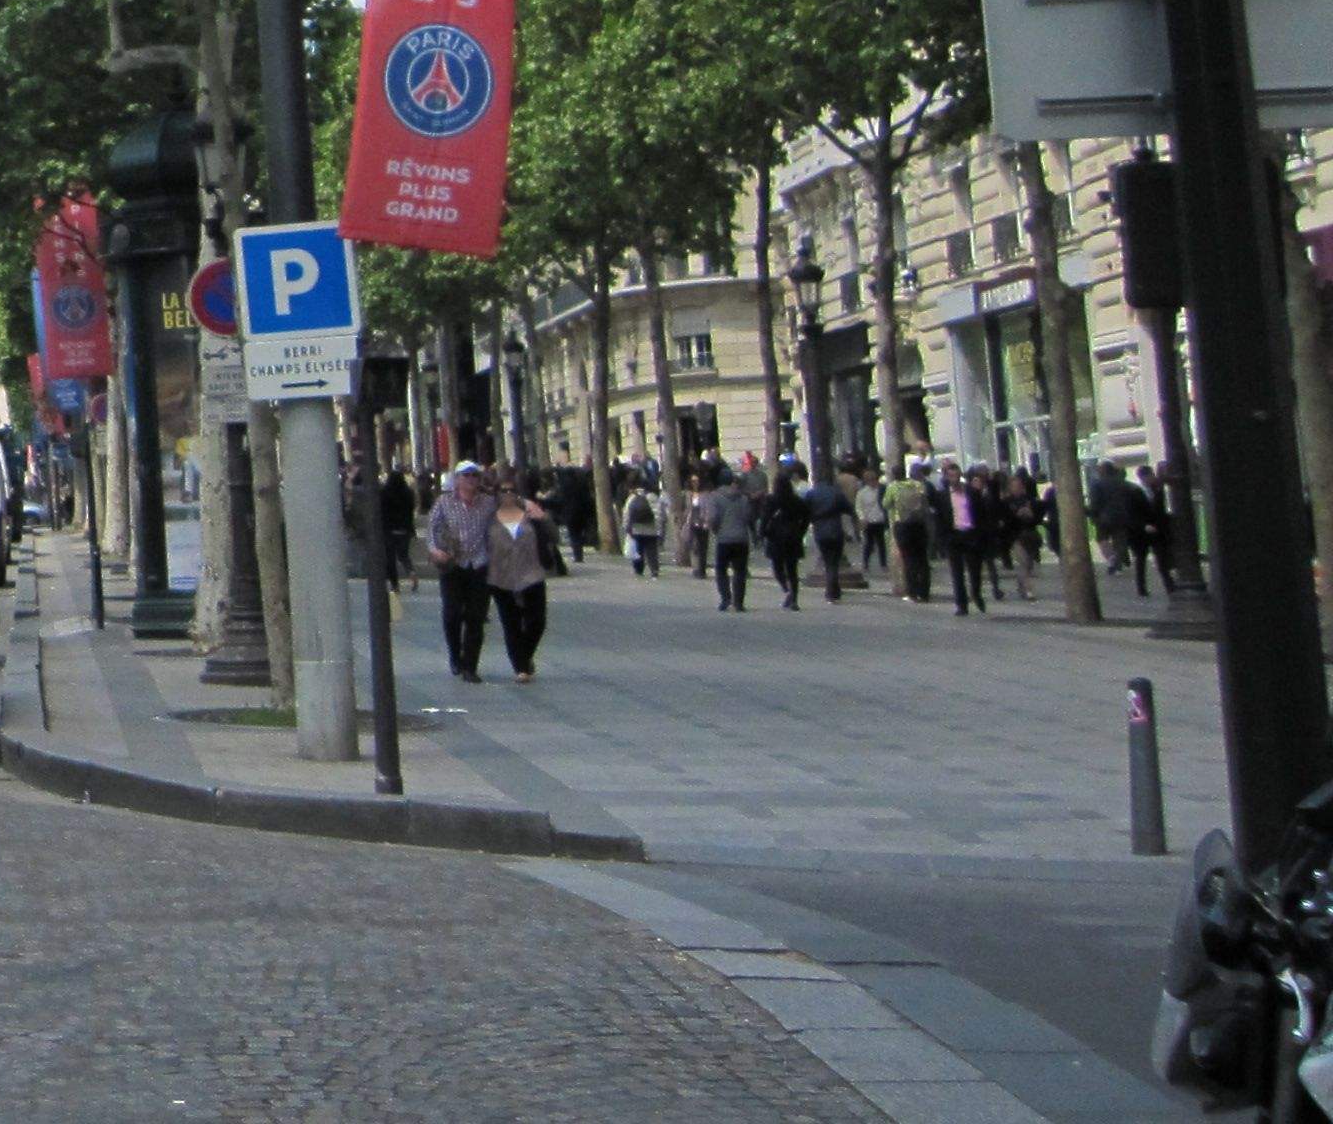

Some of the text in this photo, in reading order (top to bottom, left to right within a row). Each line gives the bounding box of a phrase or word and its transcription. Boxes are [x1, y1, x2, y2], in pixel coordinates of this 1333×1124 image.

[404, 30, 476, 61] PARIS
[386, 158, 472, 184] RÊVONS
[398, 182, 452, 203] PLUS
[385, 201, 459, 224] GRAND
[269, 247, 321, 317] P
[162, 292, 180, 309] LA
[283, 344, 325, 358] BERRI
[249, 363, 302, 378] CHAMPS
